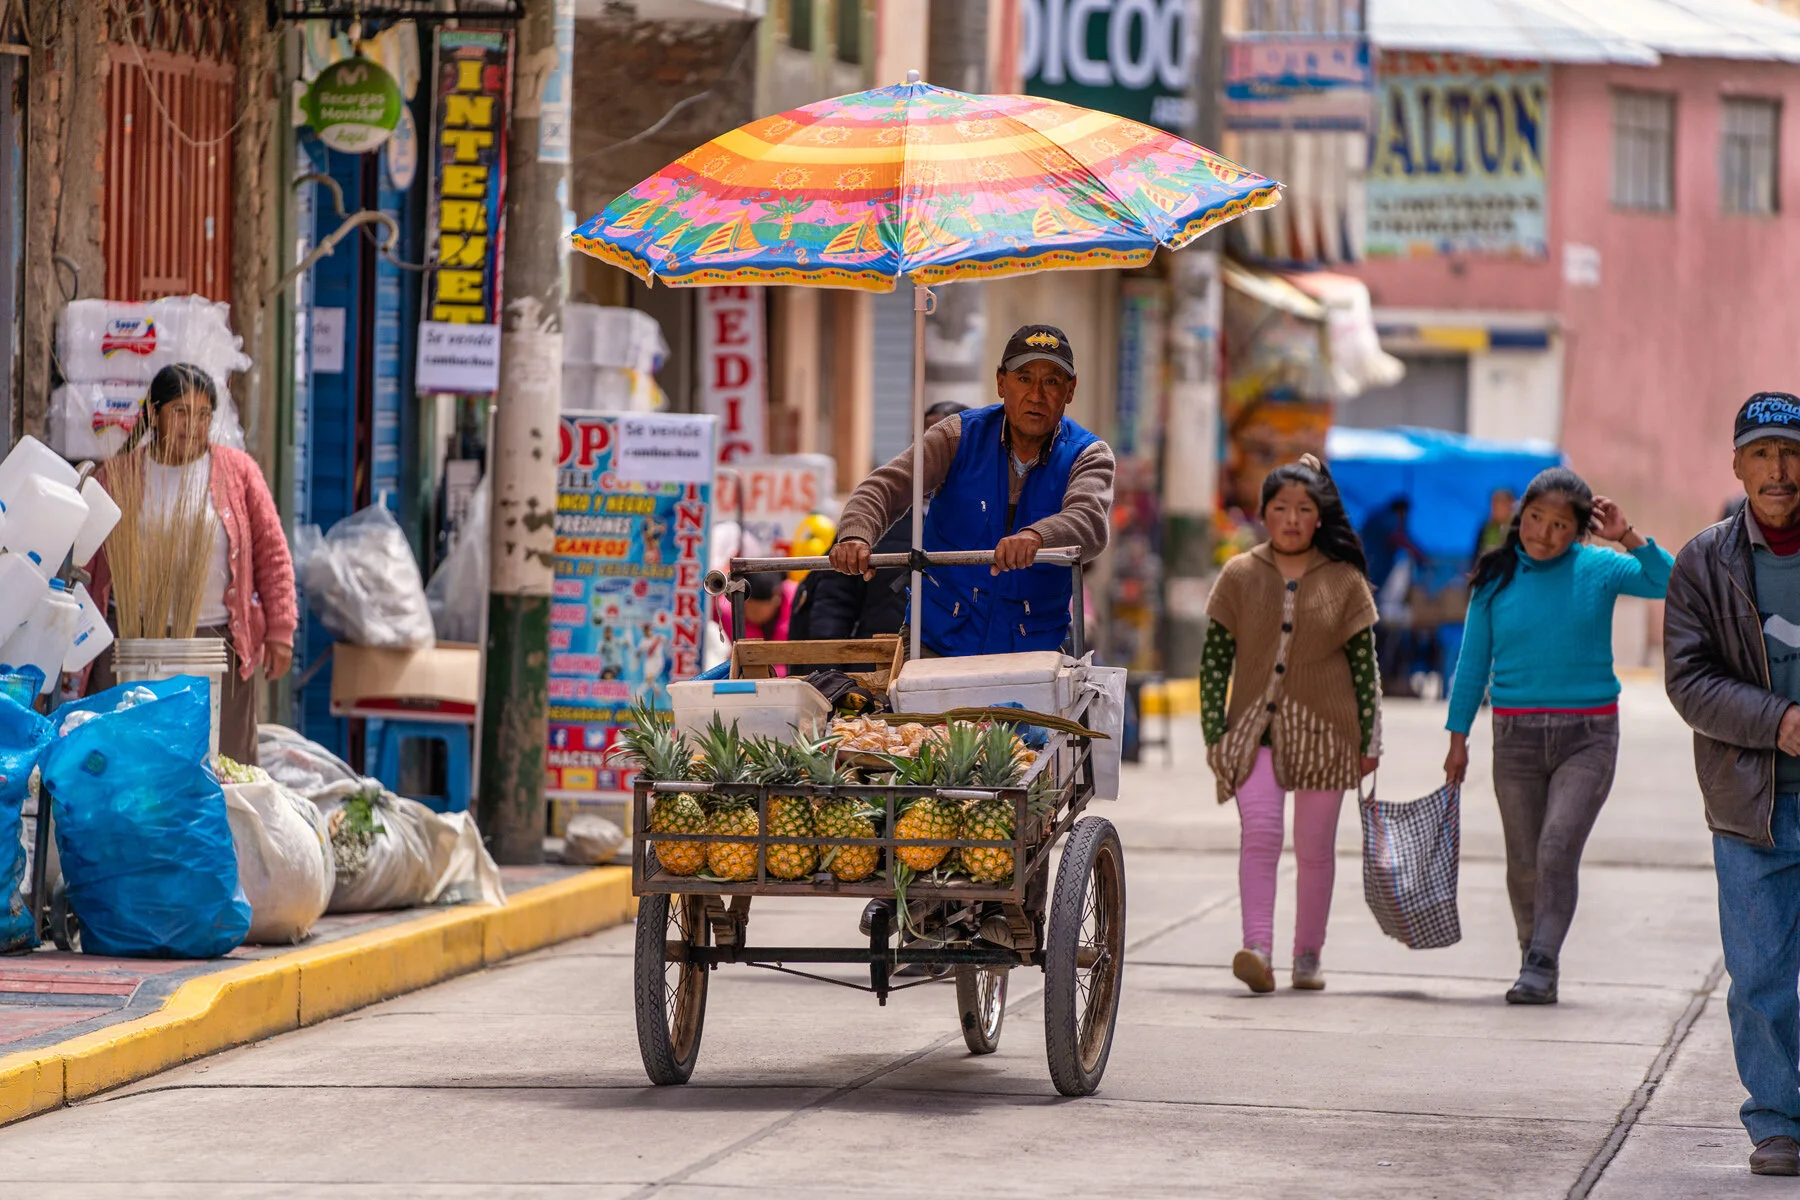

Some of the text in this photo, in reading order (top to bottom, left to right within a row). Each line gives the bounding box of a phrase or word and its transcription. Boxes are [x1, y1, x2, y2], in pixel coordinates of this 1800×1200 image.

[320, 92, 386, 107] Recargas
[320, 107, 385, 121] Movistar
[1367, 84, 1546, 176] ALTON
[432, 60, 495, 325] INTERNET
[426, 330, 495, 346] Se vende
[625, 422, 701, 438] Se vende
[674, 484, 704, 683] INTERNE
